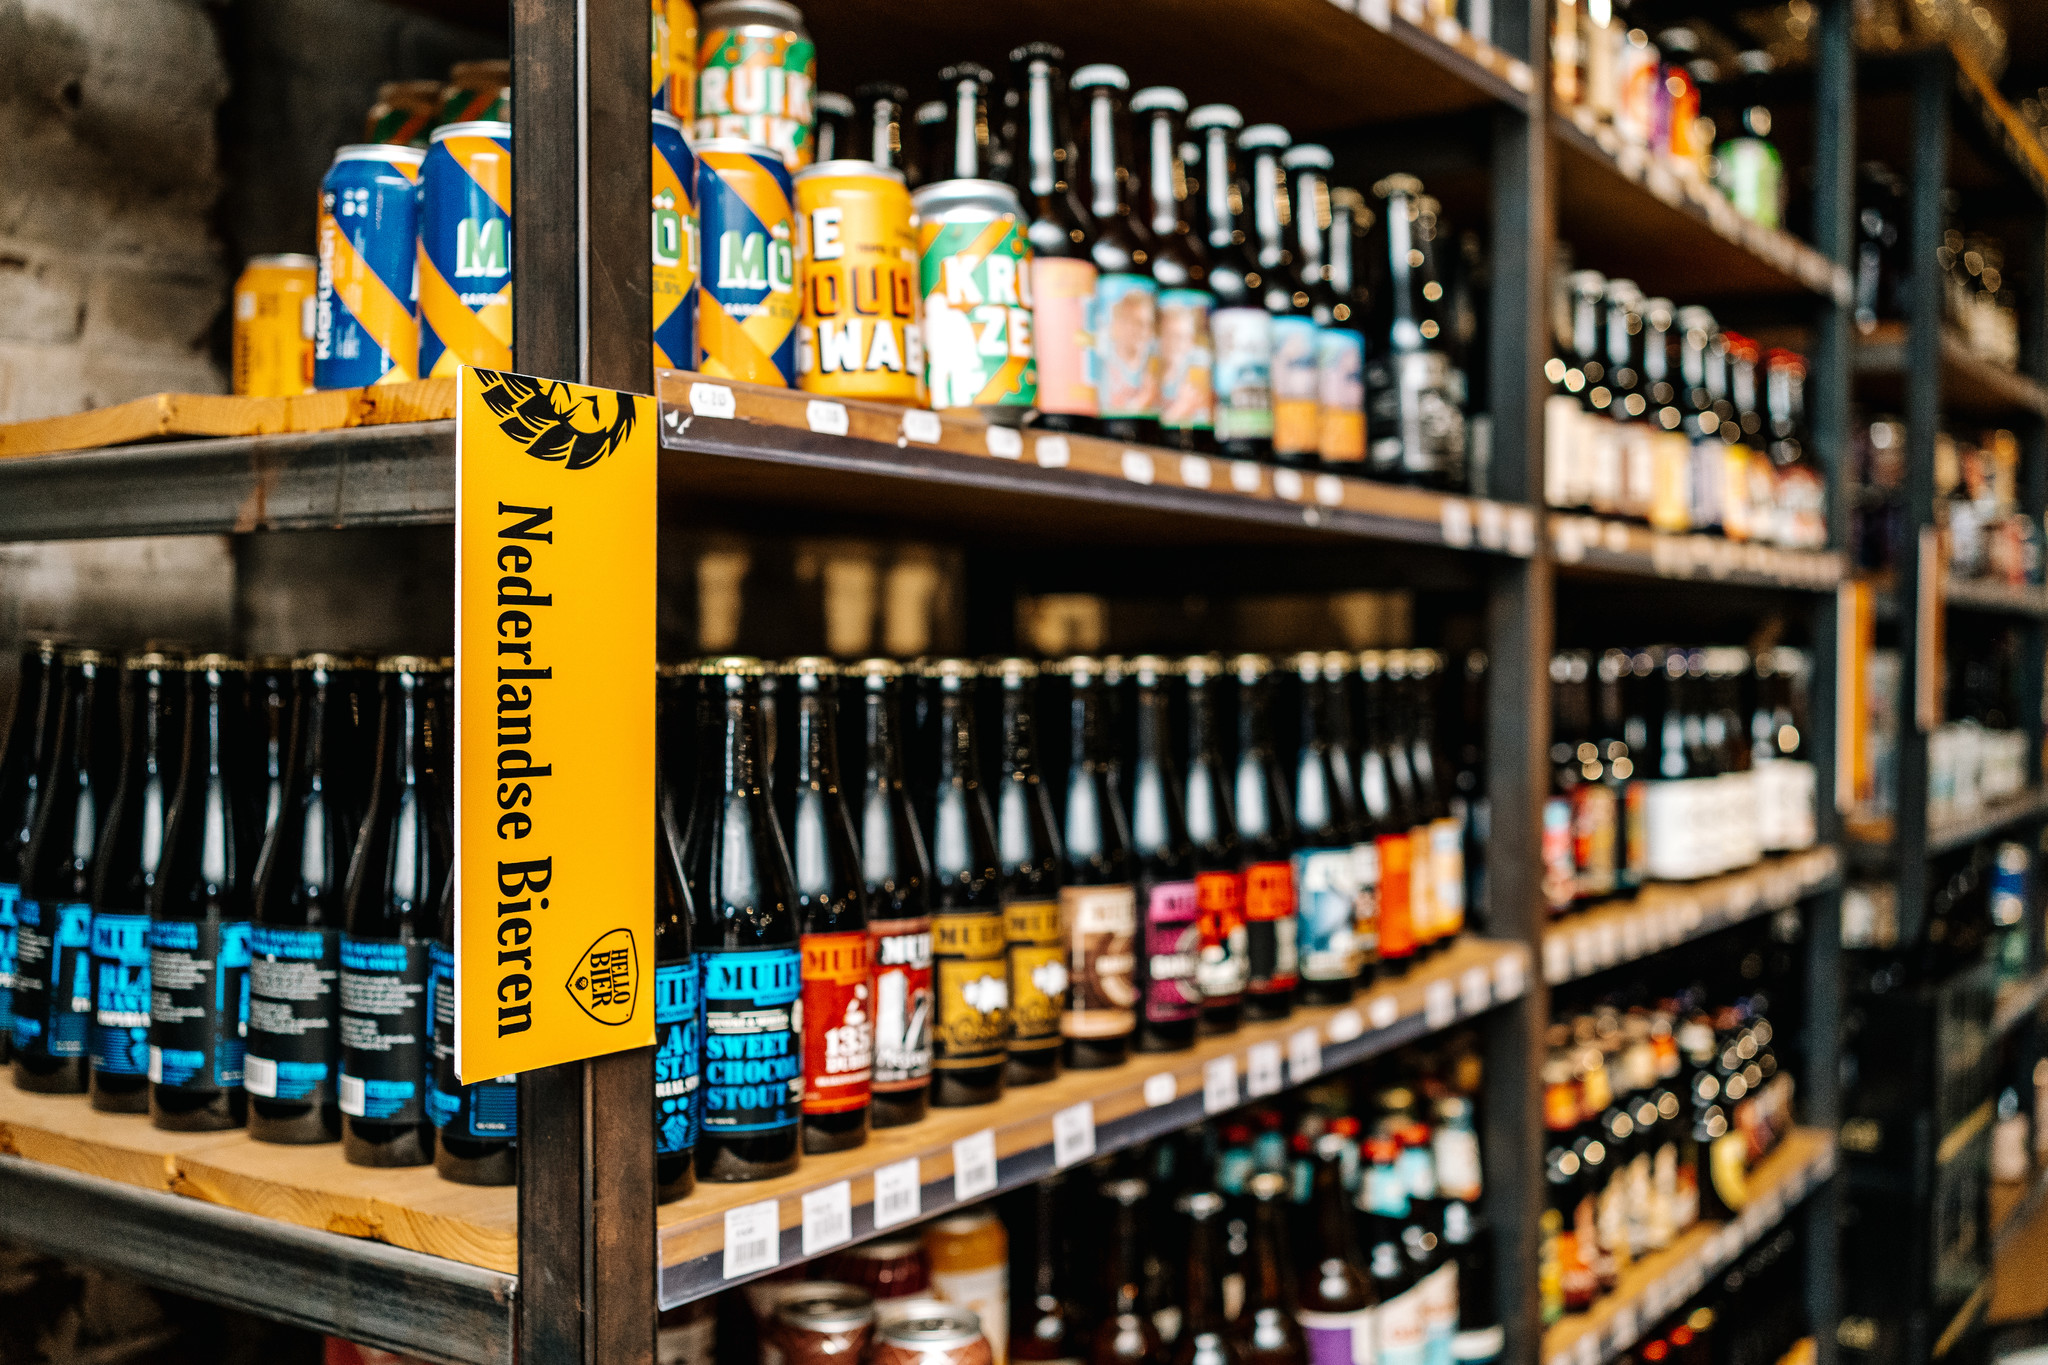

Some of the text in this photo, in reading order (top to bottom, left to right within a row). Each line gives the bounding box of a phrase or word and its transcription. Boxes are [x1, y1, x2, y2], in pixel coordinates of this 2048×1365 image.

[497, 501, 553, 1038] Nederlandse Bieren
[590, 951, 613, 1010] BIER
[611, 948, 631, 1005] HELLO
[706, 1031, 790, 1059] SWEET
[706, 1083, 787, 1110] STOUT
